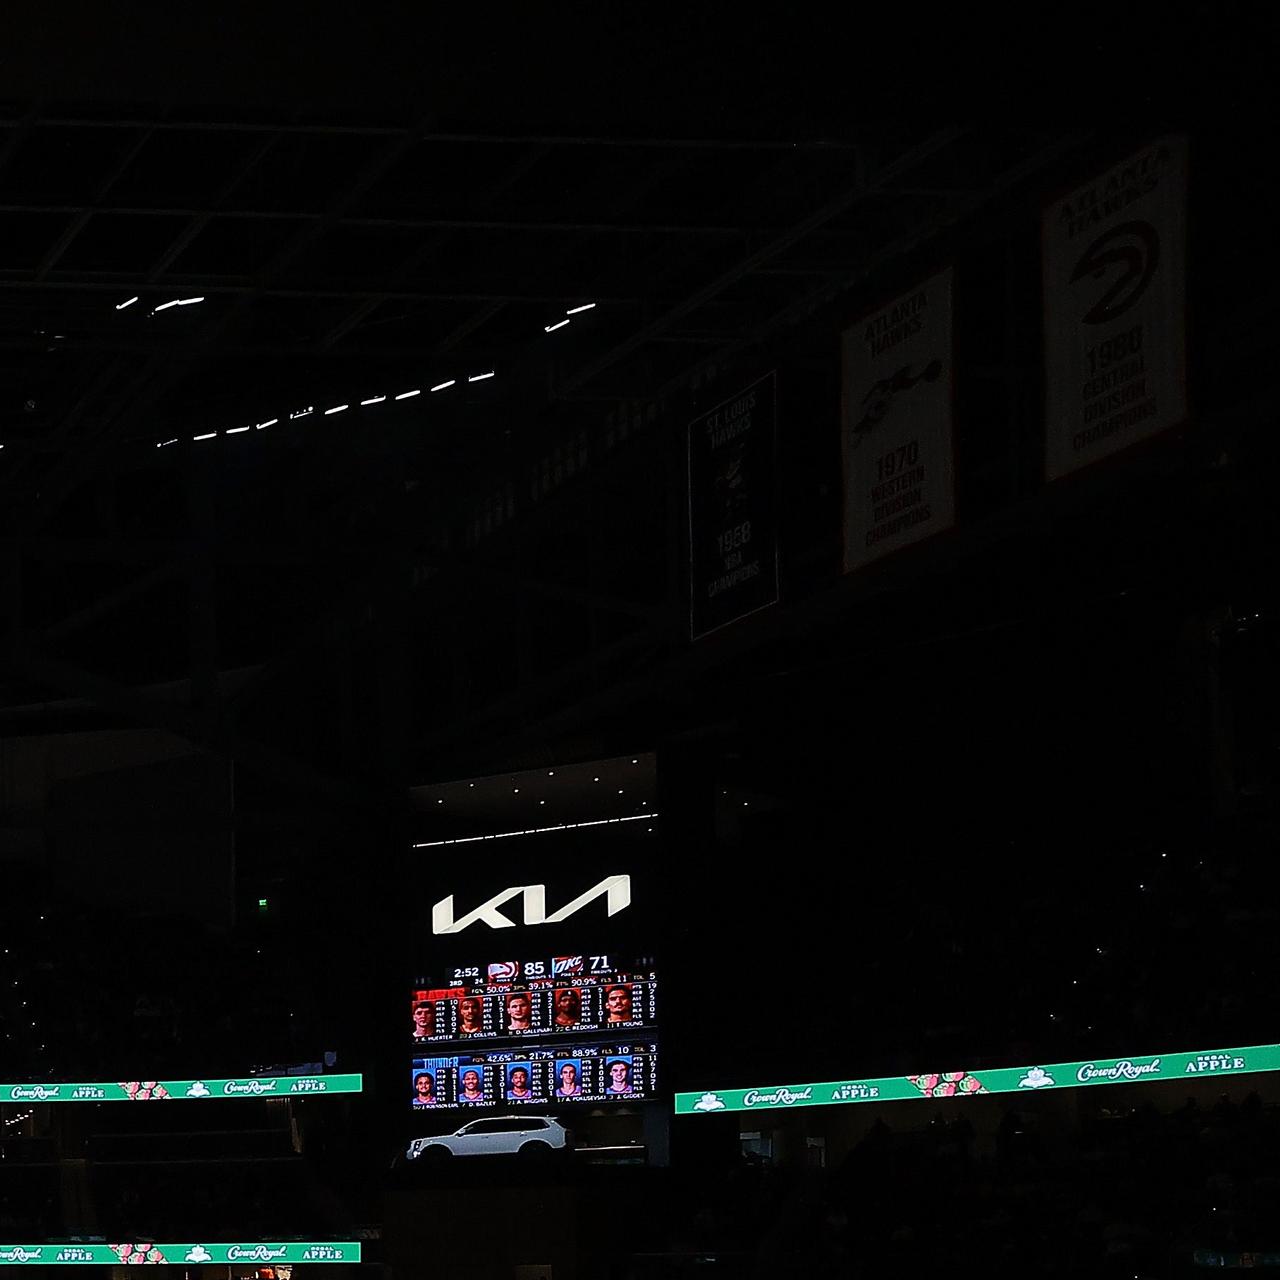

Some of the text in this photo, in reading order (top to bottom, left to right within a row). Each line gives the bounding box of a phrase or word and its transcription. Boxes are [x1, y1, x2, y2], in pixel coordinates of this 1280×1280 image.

[432, 874, 630, 934] KIA
[523, 961, 545, 976] 85
[589, 955, 610, 970] 71
[454, 967, 480, 978] 2:52
[486, 972, 656, 994] 50.0% 39.1% 90.9% 11 5
[487, 1044, 656, 1063] 42.6% 21.7% 88.9% 10 3
[1186, 1057, 1245, 1073] APPLE
[73, 1086, 104, 1098] APPLE
[832, 1087, 879, 1100] APPLE
